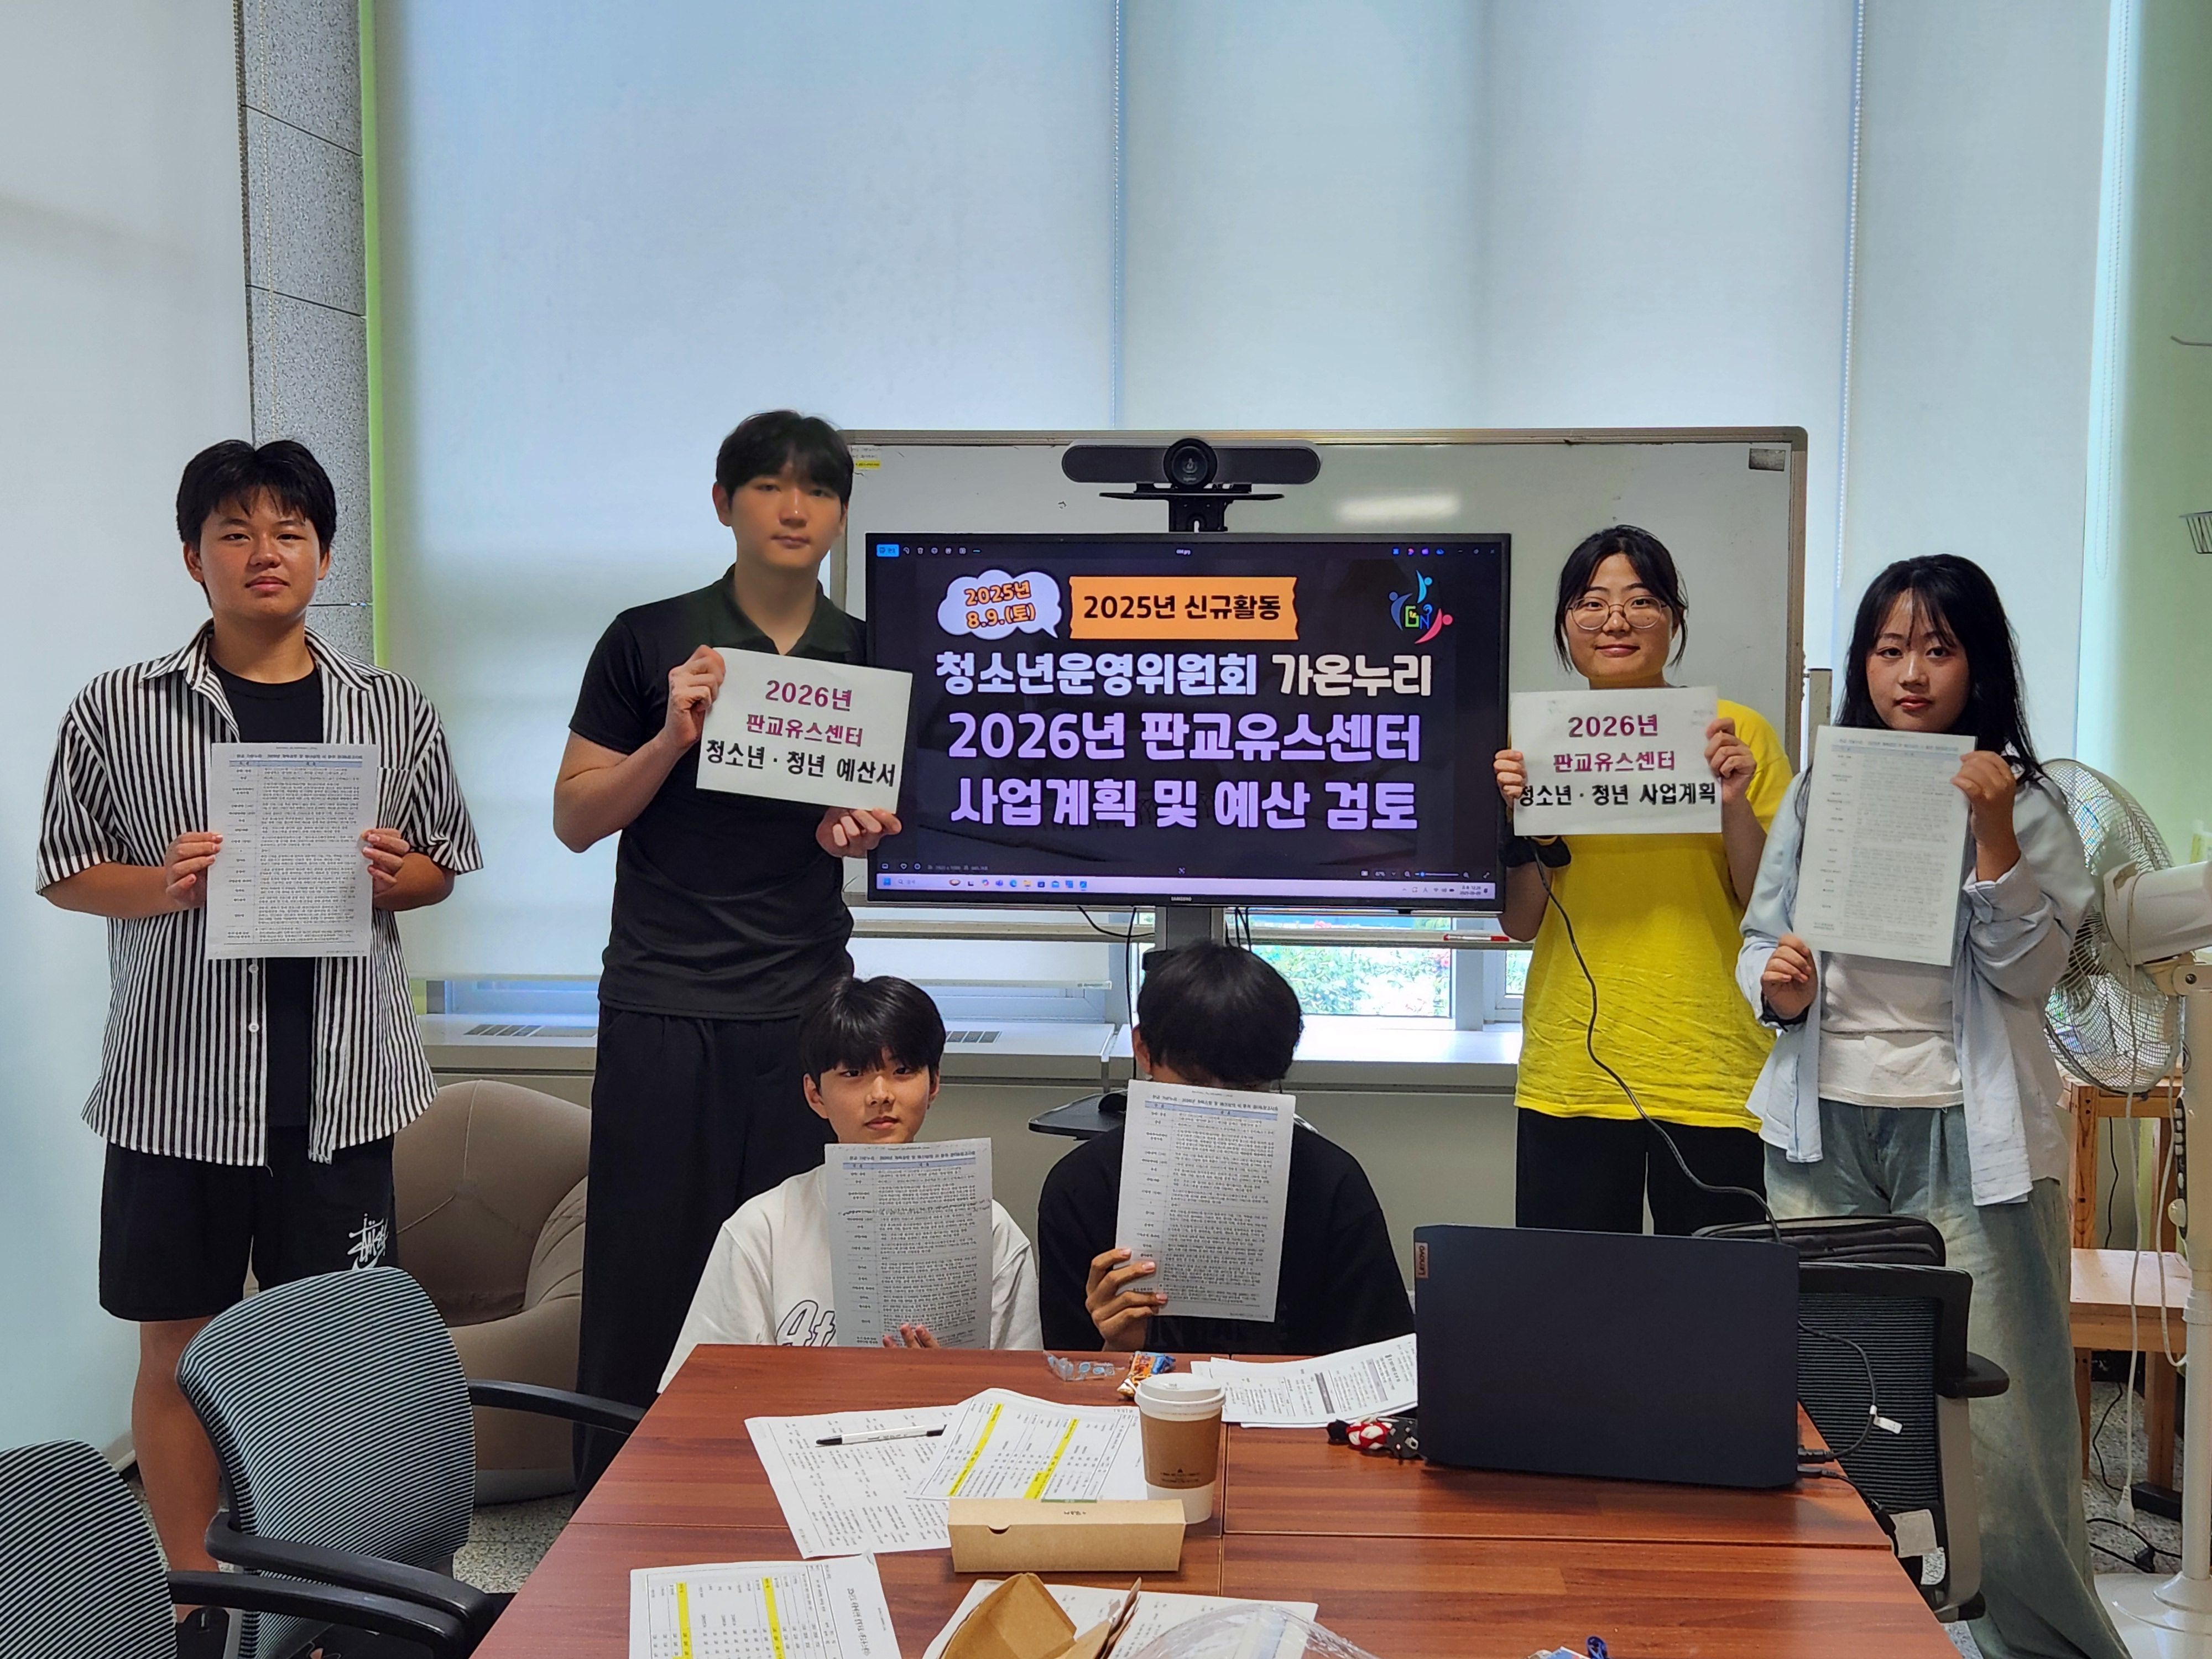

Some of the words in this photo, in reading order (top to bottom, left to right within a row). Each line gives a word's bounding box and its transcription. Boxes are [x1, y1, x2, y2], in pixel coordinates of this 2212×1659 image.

[964, 580, 1031, 606] 2025년
[966, 603, 1036, 629] 8.9.(토)
[1084, 594, 1176, 620] 2025년
[1184, 594, 1281, 621] 신규활동
[936, 651, 1257, 697] 청소년운영위원회
[1271, 654, 1432, 697] 가온누리
[765, 680, 853, 712] 2026년
[746, 713, 863, 747] 판교유스센터
[948, 711, 1125, 760] 2026년
[1140, 712, 1421, 763] 판교유스센터
[1568, 713, 1658, 738] 2026년
[836, 758, 896, 787] 예산서
[1553, 750, 1675, 773] 판교유스센터
[950, 778, 1136, 827] 사업계획
[1154, 780, 1197, 828] 및
[1214, 780, 1311, 830] 예산
[1324, 781, 1418, 831] 검토
[1639, 782, 1716, 805] 사업계획
